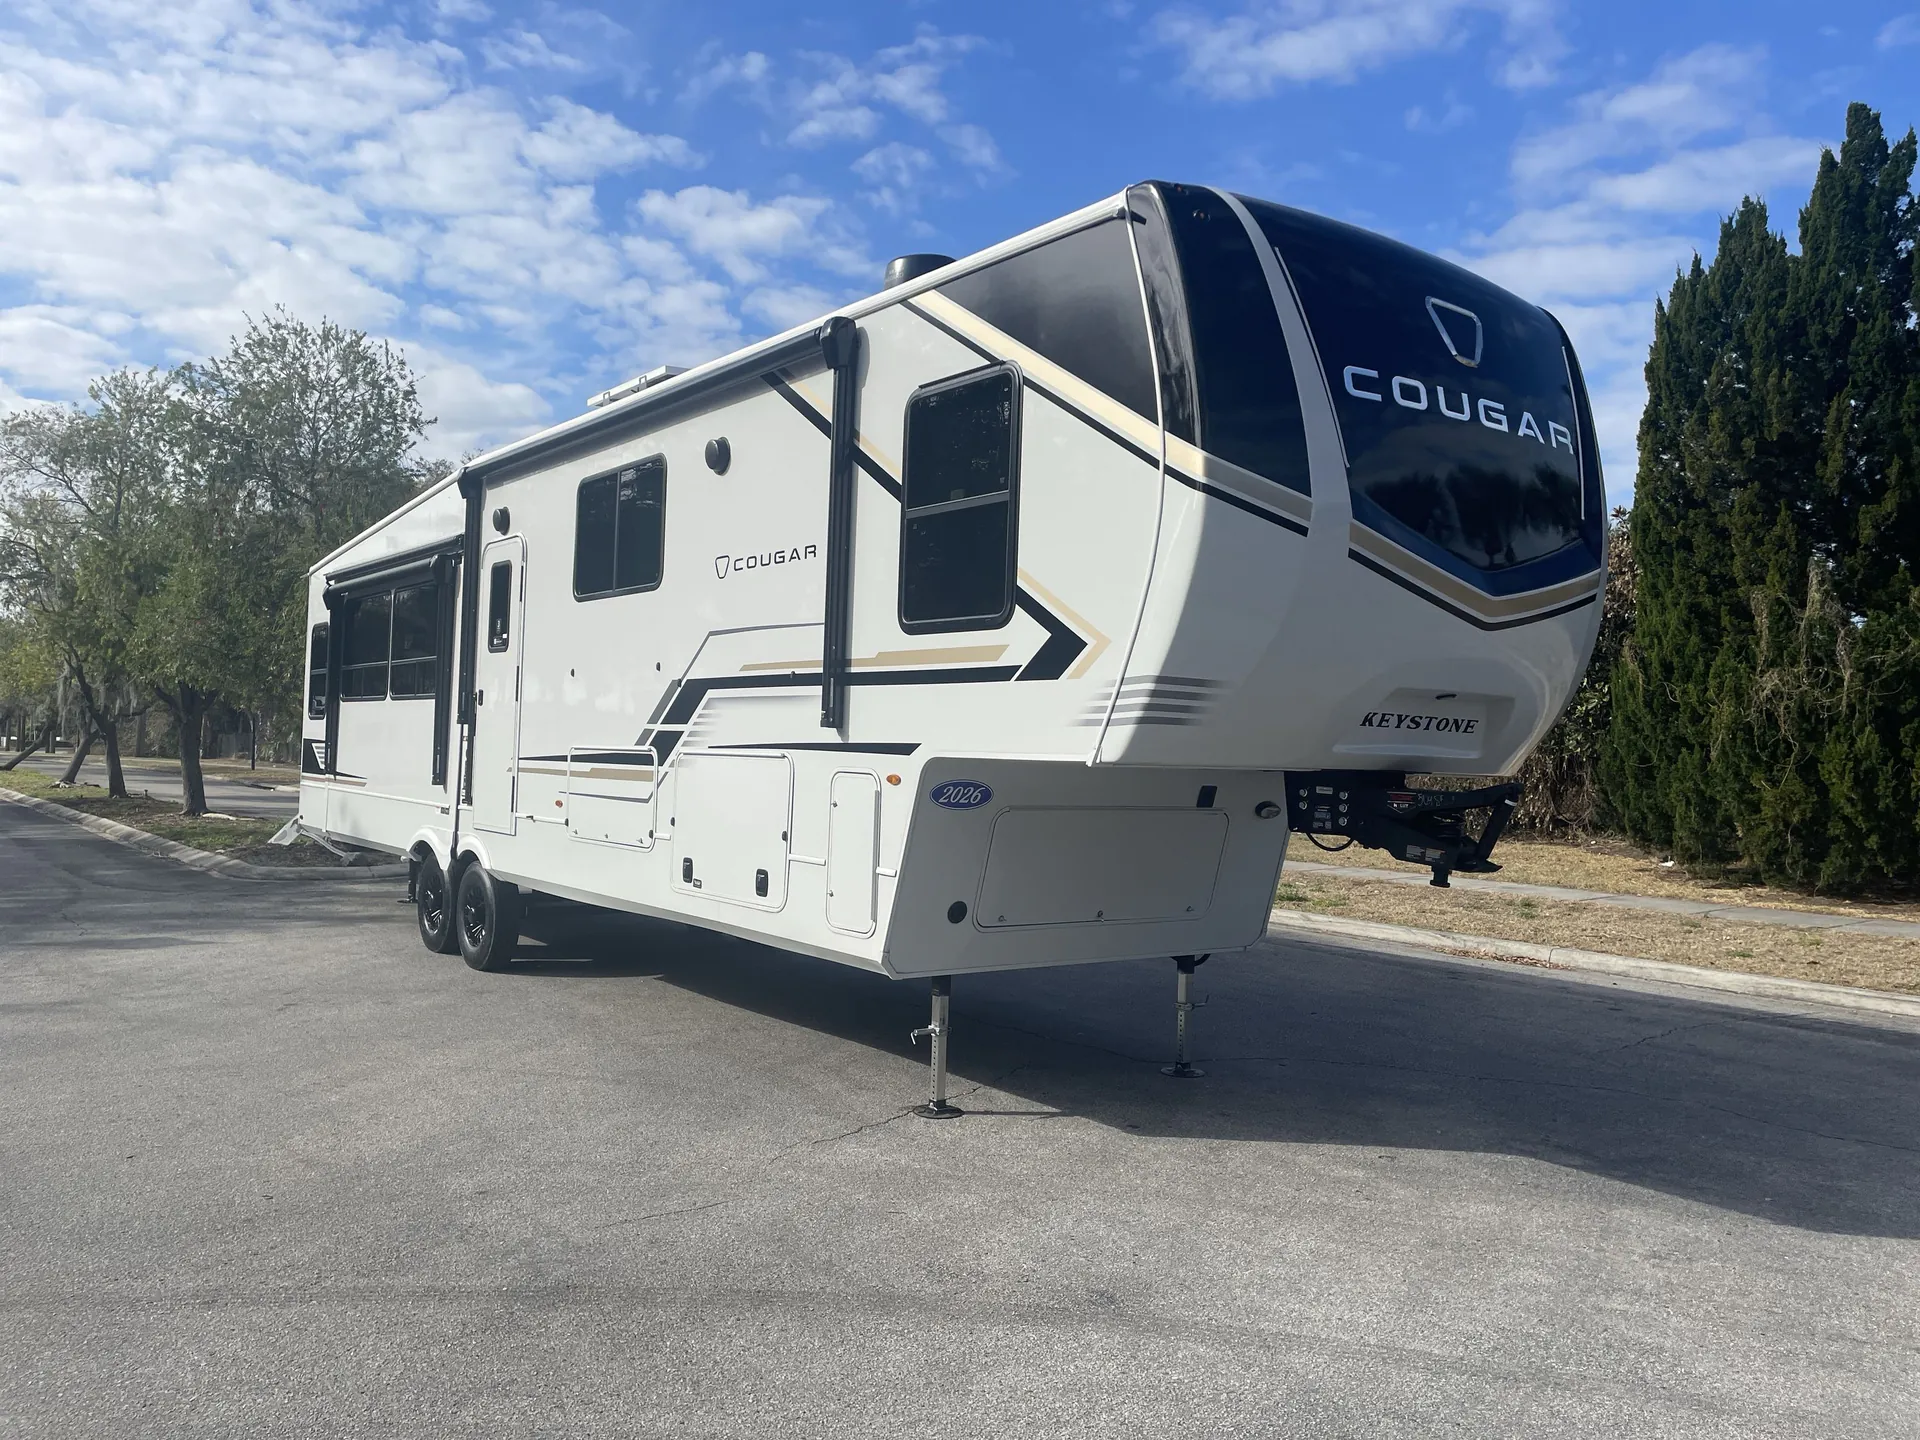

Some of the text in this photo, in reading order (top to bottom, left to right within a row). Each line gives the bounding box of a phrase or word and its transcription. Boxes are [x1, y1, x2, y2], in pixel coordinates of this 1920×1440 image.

[1343, 365, 1574, 455] COUGAR
[733, 544, 817, 572] COUGAR
[1360, 712, 1479, 734] KEYSTONE
[938, 786, 986, 804] 2026
